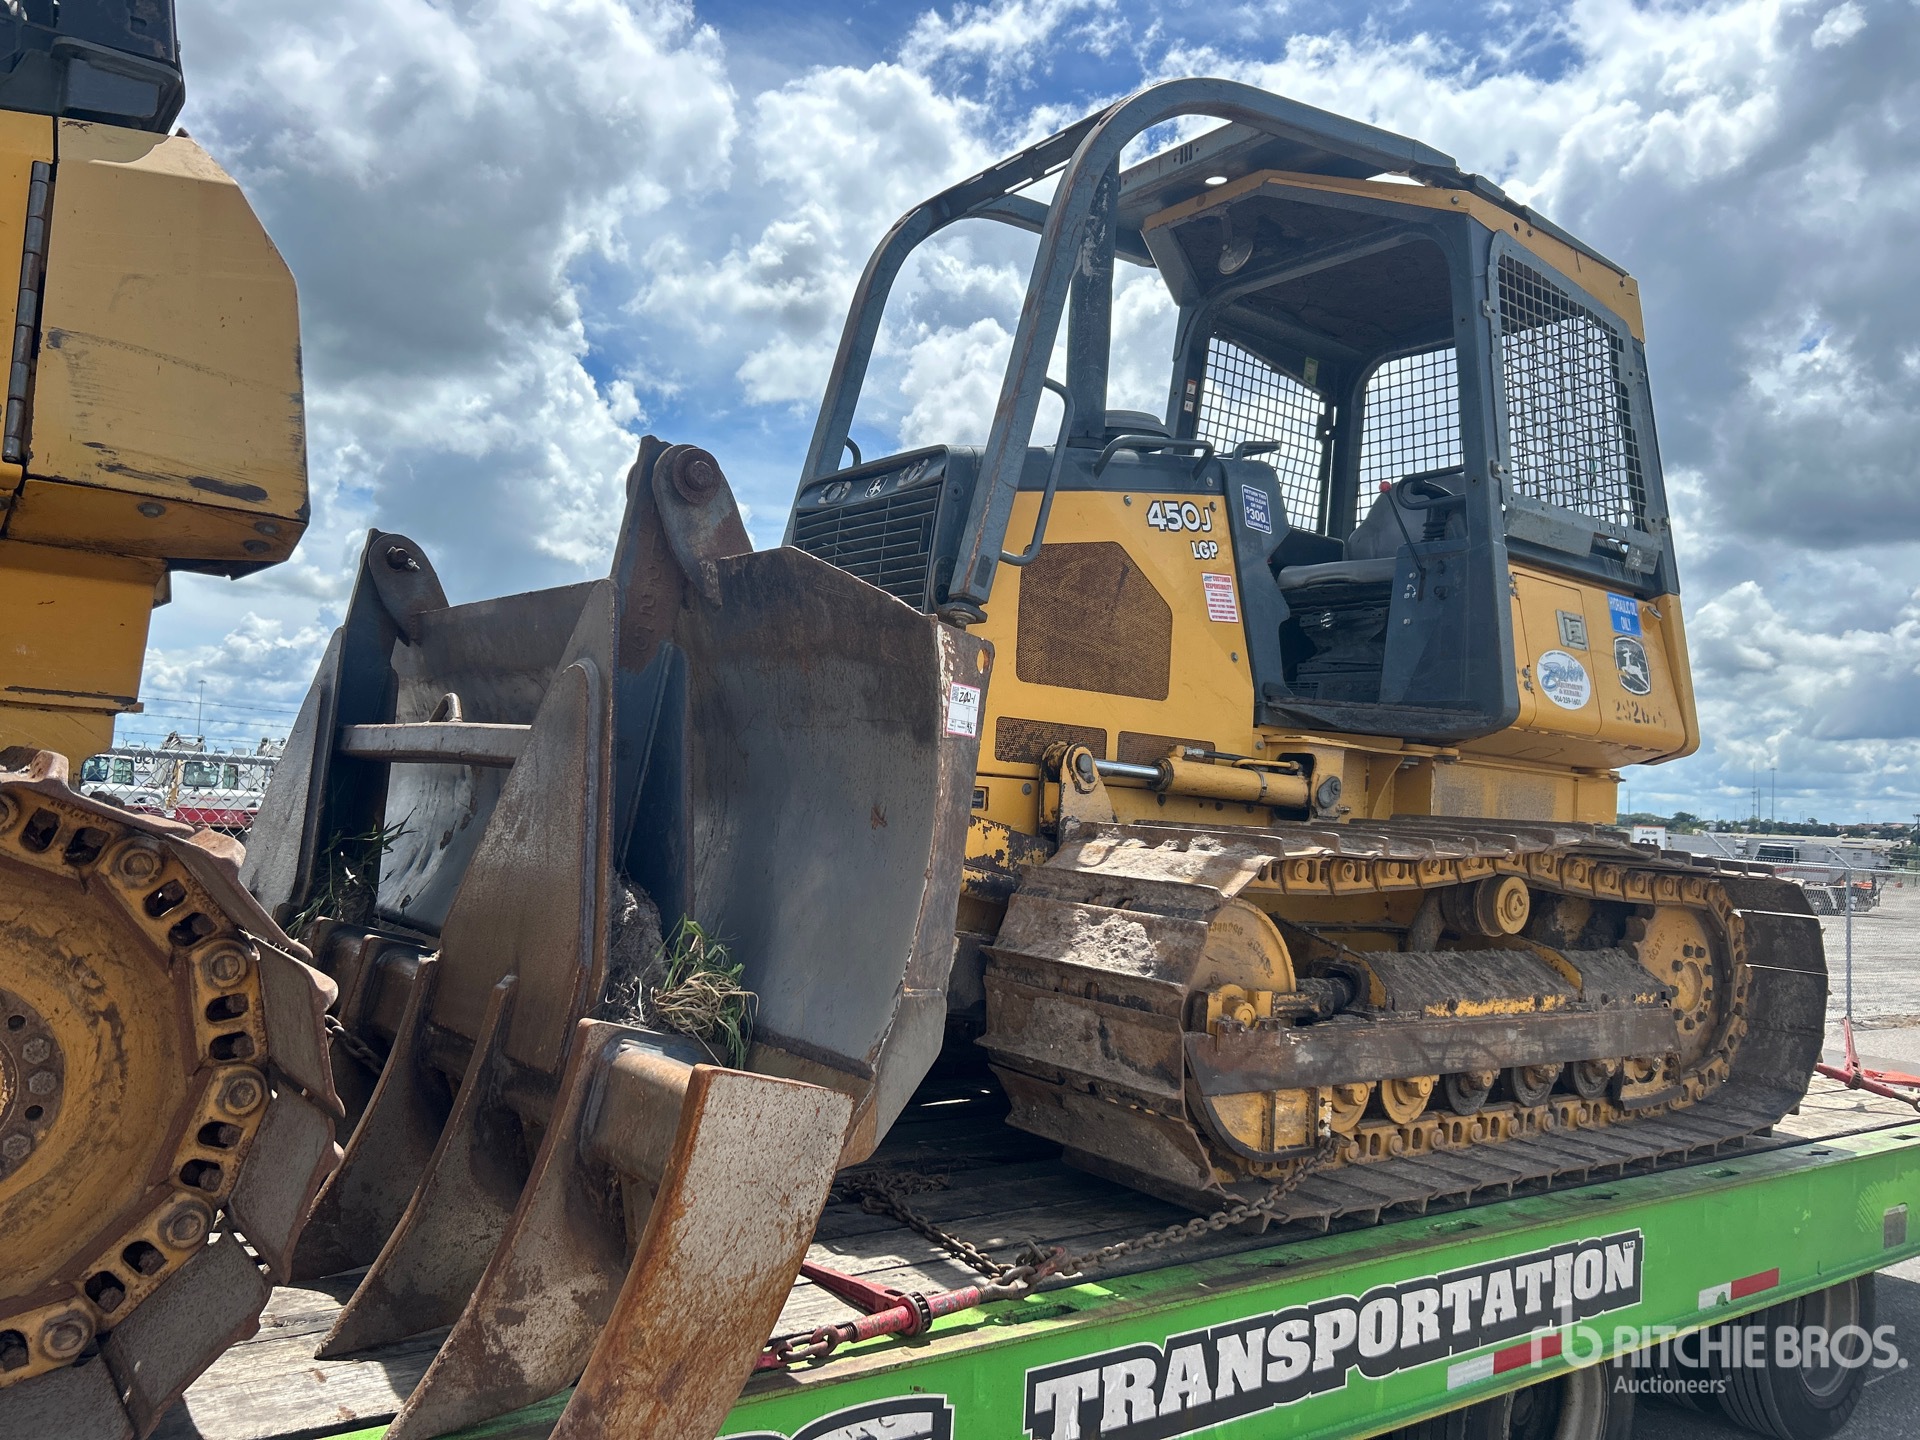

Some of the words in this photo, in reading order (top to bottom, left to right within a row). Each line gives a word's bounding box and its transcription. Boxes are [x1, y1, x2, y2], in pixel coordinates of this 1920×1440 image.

[1146, 500, 1212, 532] 450J
[1190, 540, 1219, 560] LGP
[1034, 1241, 1636, 1440] TRANSPORTATION
